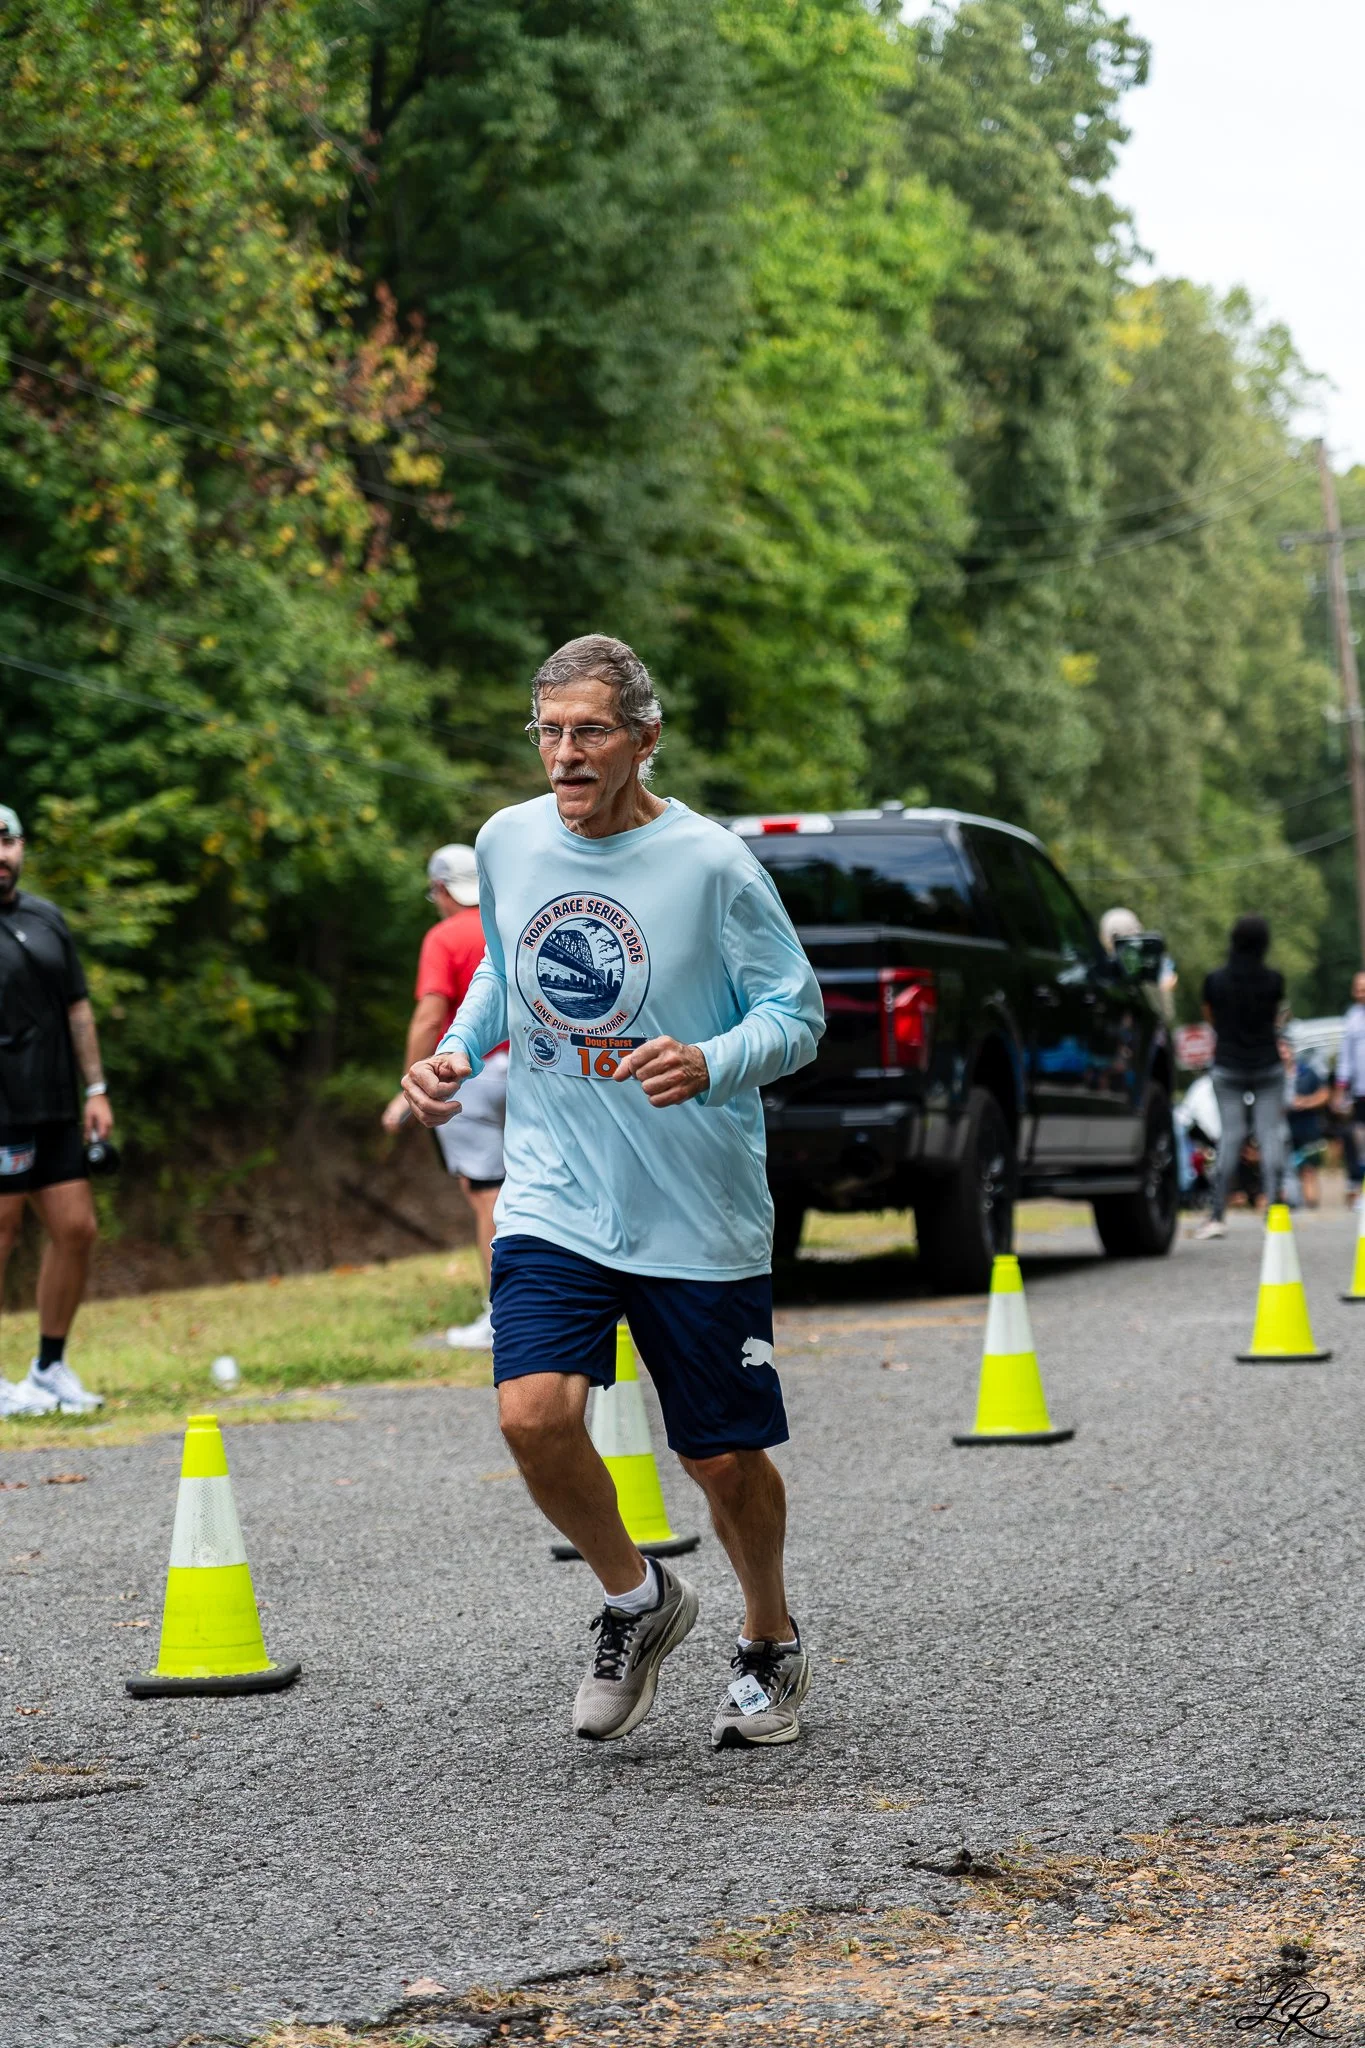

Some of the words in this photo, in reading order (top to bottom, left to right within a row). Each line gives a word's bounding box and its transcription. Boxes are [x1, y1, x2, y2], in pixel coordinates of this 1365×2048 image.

[522, 912, 552, 949] ROAD
[552, 899, 584, 919] RACE
[586, 899, 628, 930] SERIES
[621, 928, 644, 963] 2026
[533, 1000, 553, 1023] LANE
[587, 1011, 628, 1036] MEMORIAL
[585, 1037, 608, 1048] Doug
